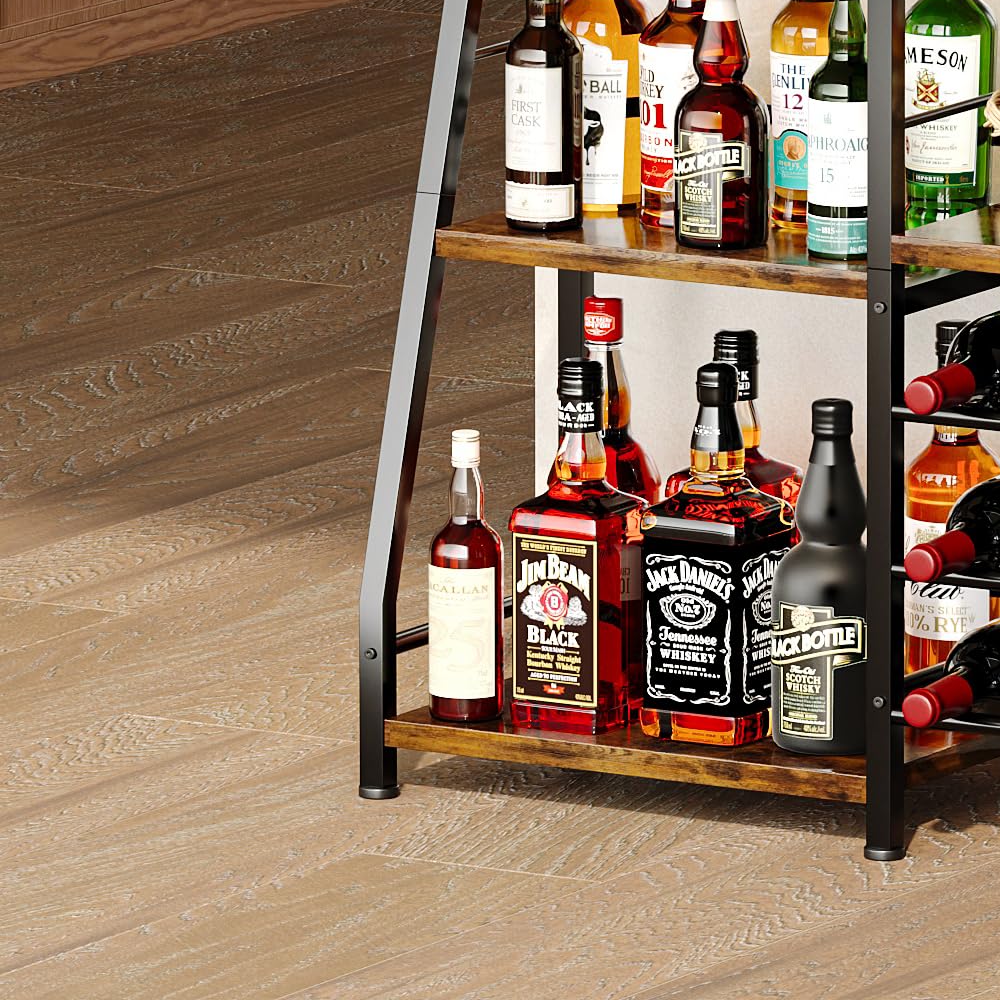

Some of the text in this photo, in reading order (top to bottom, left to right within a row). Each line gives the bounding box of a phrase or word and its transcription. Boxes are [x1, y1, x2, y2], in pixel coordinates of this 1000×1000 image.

[904, 46, 968, 73] MESON
[781, 63, 806, 75] THE
[511, 99, 542, 113] FIRST
[784, 93, 804, 110] 12
[511, 113, 541, 128] CASK
[641, 100, 667, 129] 01
[920, 123, 957, 132] WHISKEY
[697, 148, 740, 168] BOTTLE
[820, 167, 834, 184] 15
[685, 186, 713, 196] SCOTCH
[685, 193, 713, 203] WHISKY
[559, 400, 595, 413] LACK
[517, 559, 547, 593] JIM
[547, 554, 592, 602] BEAM
[646, 566, 680, 592] JACK
[680, 560, 735, 600] DANIEL'S
[430, 583, 489, 594] CALLAN
[933, 616, 969, 634] RYE
[527, 624, 580, 649] BLACK
[659, 626, 717, 647] Tennessee
[801, 627, 856, 652] BOTTLE
[660, 648, 716, 664] WHISKEY
[786, 672, 821, 685] SCOTCH
[786, 681, 821, 694] WHISKY
